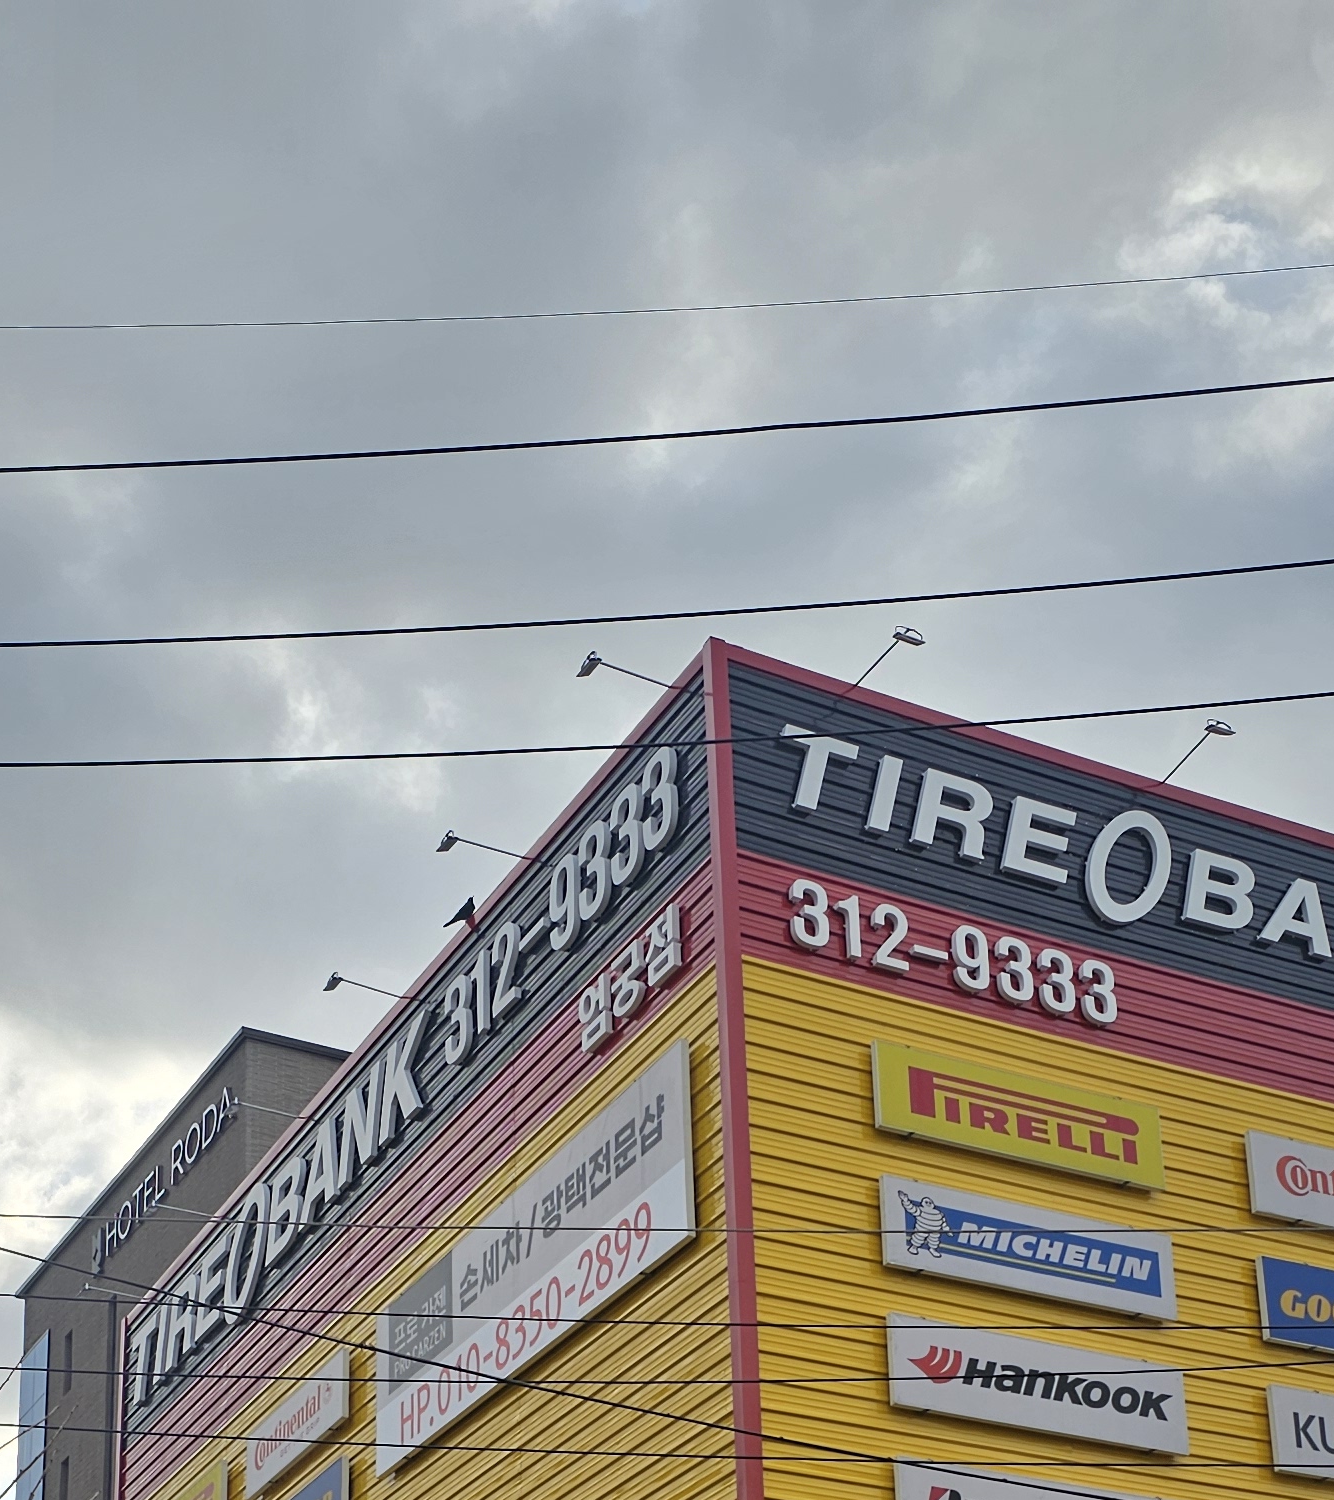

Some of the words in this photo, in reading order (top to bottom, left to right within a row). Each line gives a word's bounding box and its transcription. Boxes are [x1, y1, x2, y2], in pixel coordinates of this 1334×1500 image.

[445, 747, 679, 1066] 312-9333
[579, 903, 682, 1053] 엄궁점
[788, 879, 1118, 1026] 312-9333
[105, 1165, 166, 1256] HOTEL
[171, 1087, 233, 1185] RODA
[908, 1066, 1139, 1165] PIRELLI
[958, 1222, 1152, 1281] MICHELIN
[255, 1384, 321, 1470] Continental
